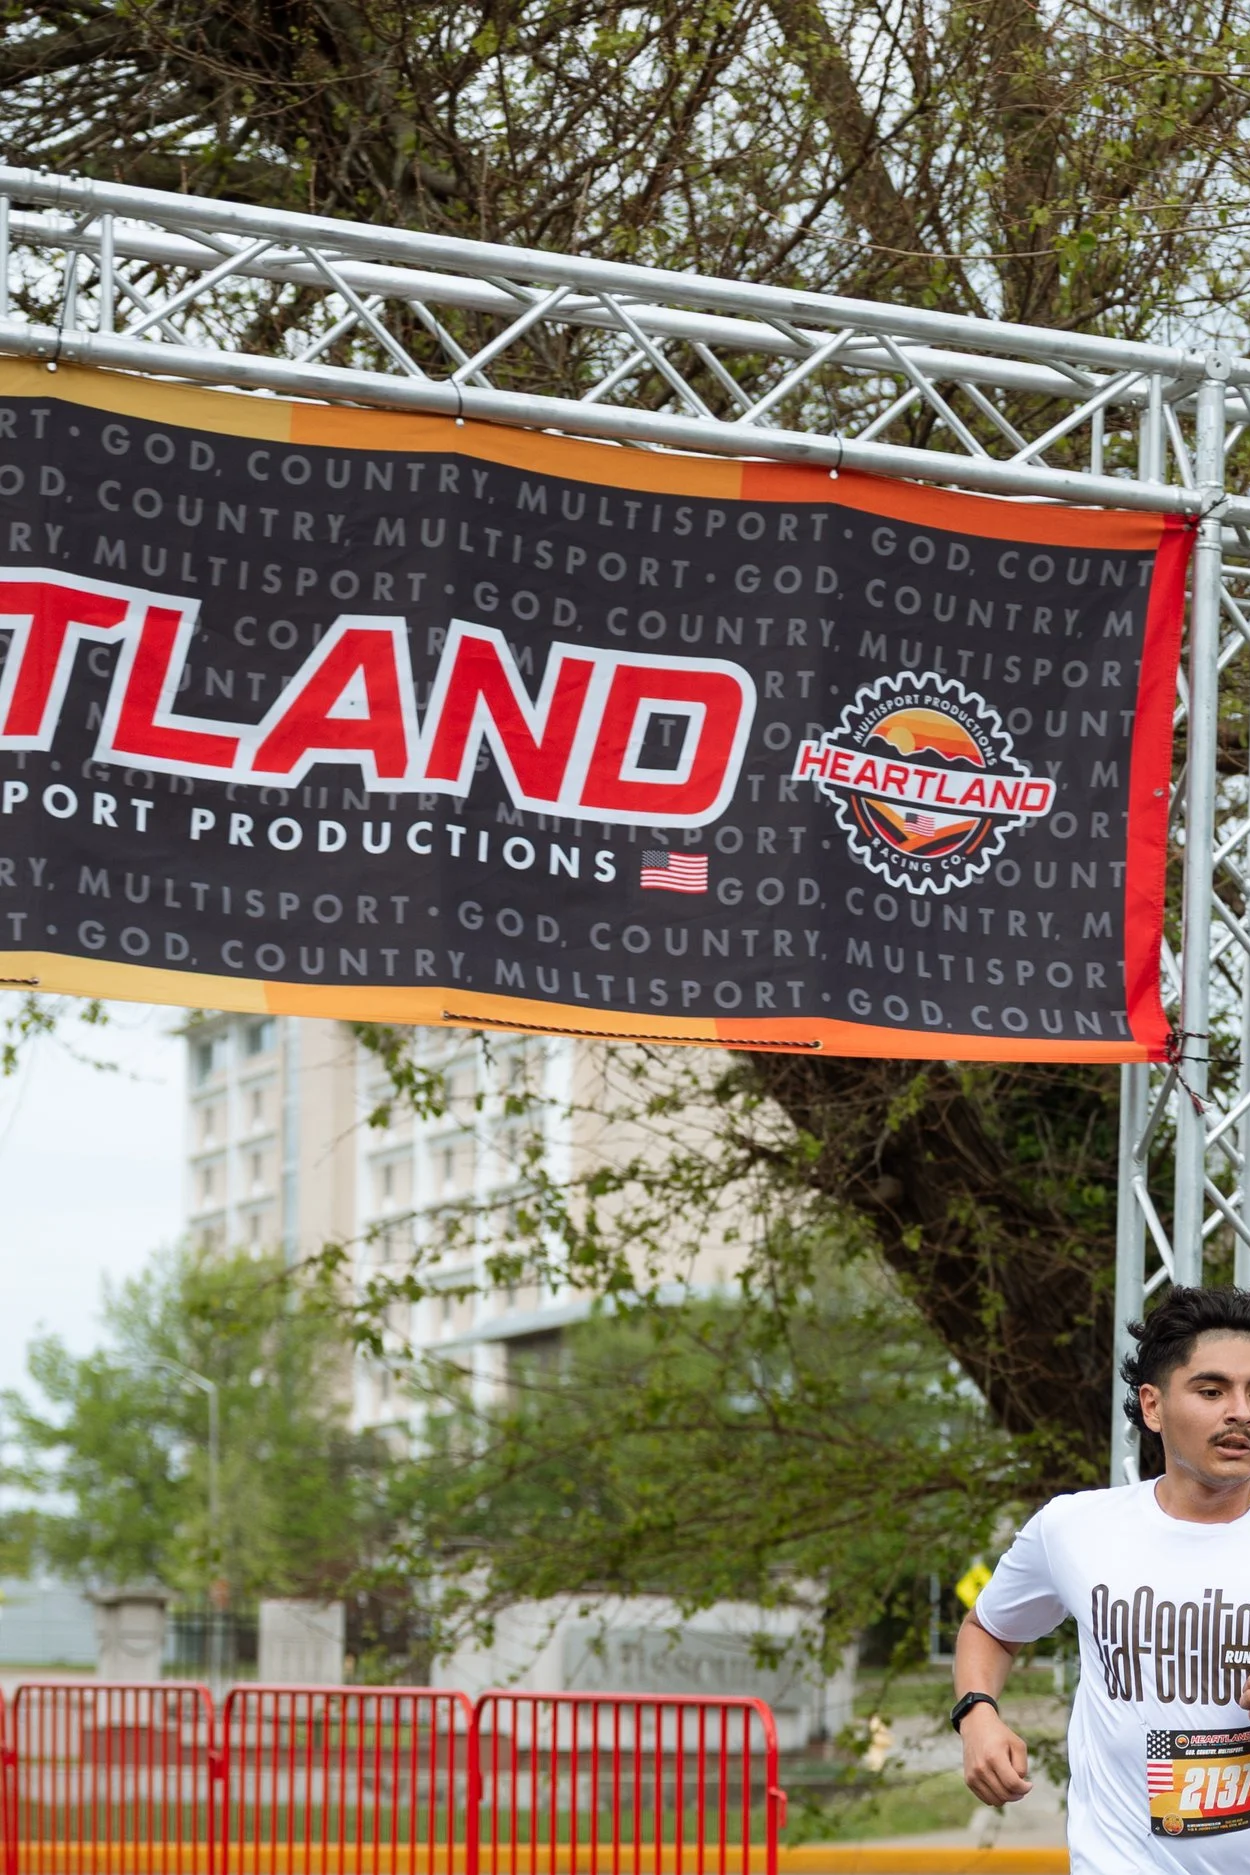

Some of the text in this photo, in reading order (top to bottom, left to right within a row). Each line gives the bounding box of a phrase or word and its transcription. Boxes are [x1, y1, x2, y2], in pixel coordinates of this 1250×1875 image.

[102, 424, 221, 478] GOD,
[247, 450, 495, 504] COUNTRY,
[517, 480, 828, 542] MULTISPORT
[871, 526, 976, 577] GOD,
[94, 535, 427, 602] MULTISPORT
[473, 581, 583, 633] GOD,
[607, 607, 839, 652] COUNTRY,
[98, 480, 351, 545] COUNTRY,
[374, 515, 690, 588] MULTISPORT
[735, 563, 843, 600] GOD,
[865, 578, 1083, 639] COUNTRY,
[853, 694, 998, 767] MULTISPORT PRODUCTIONS
[799, 744, 1052, 813] HEARTLAND
[190, 807, 617, 883] PRODUCTIONS
[871, 837, 932, 873] RACING
[77, 866, 410, 925] MULTISPORT
[458, 900, 567, 950] GOD,
[589, 921, 827, 960] COUNTRY,
[717, 877, 826, 910] GOD,
[845, 886, 1060, 941] COUNTRY,
[78, 921, 197, 966] GOD,
[222, 940, 472, 984] COUNTRY,
[495, 959, 806, 1010] MULTISPORT
[848, 988, 954, 1029] GOD,
